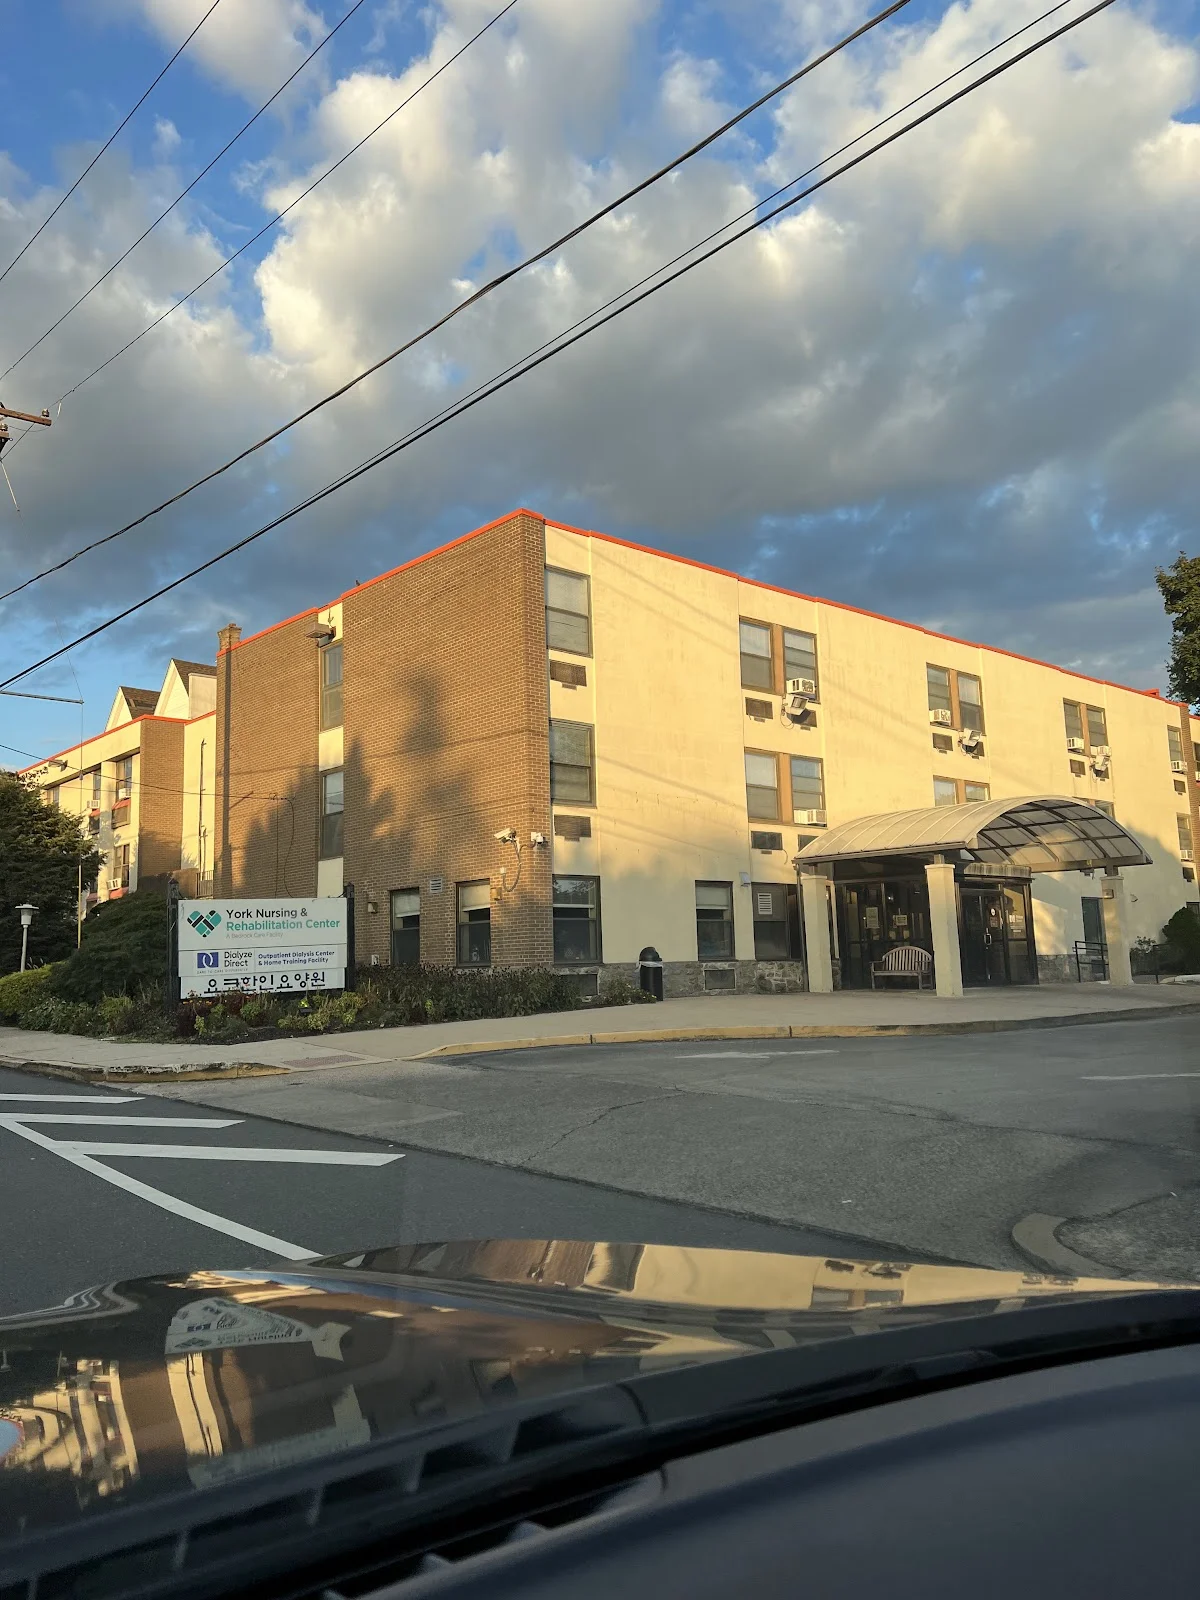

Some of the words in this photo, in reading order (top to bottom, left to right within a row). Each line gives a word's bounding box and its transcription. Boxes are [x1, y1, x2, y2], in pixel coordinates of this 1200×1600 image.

[226, 909, 253, 919] York
[256, 908, 297, 919] Nursing
[300, 908, 308, 917] &
[226, 920, 303, 931] Rehabilitation
[305, 919, 340, 929] Center
[224, 951, 253, 960] Dialyze
[258, 952, 291, 960] Outpatient
[292, 950, 315, 958] Dialysis
[224, 959, 249, 968] Direct
